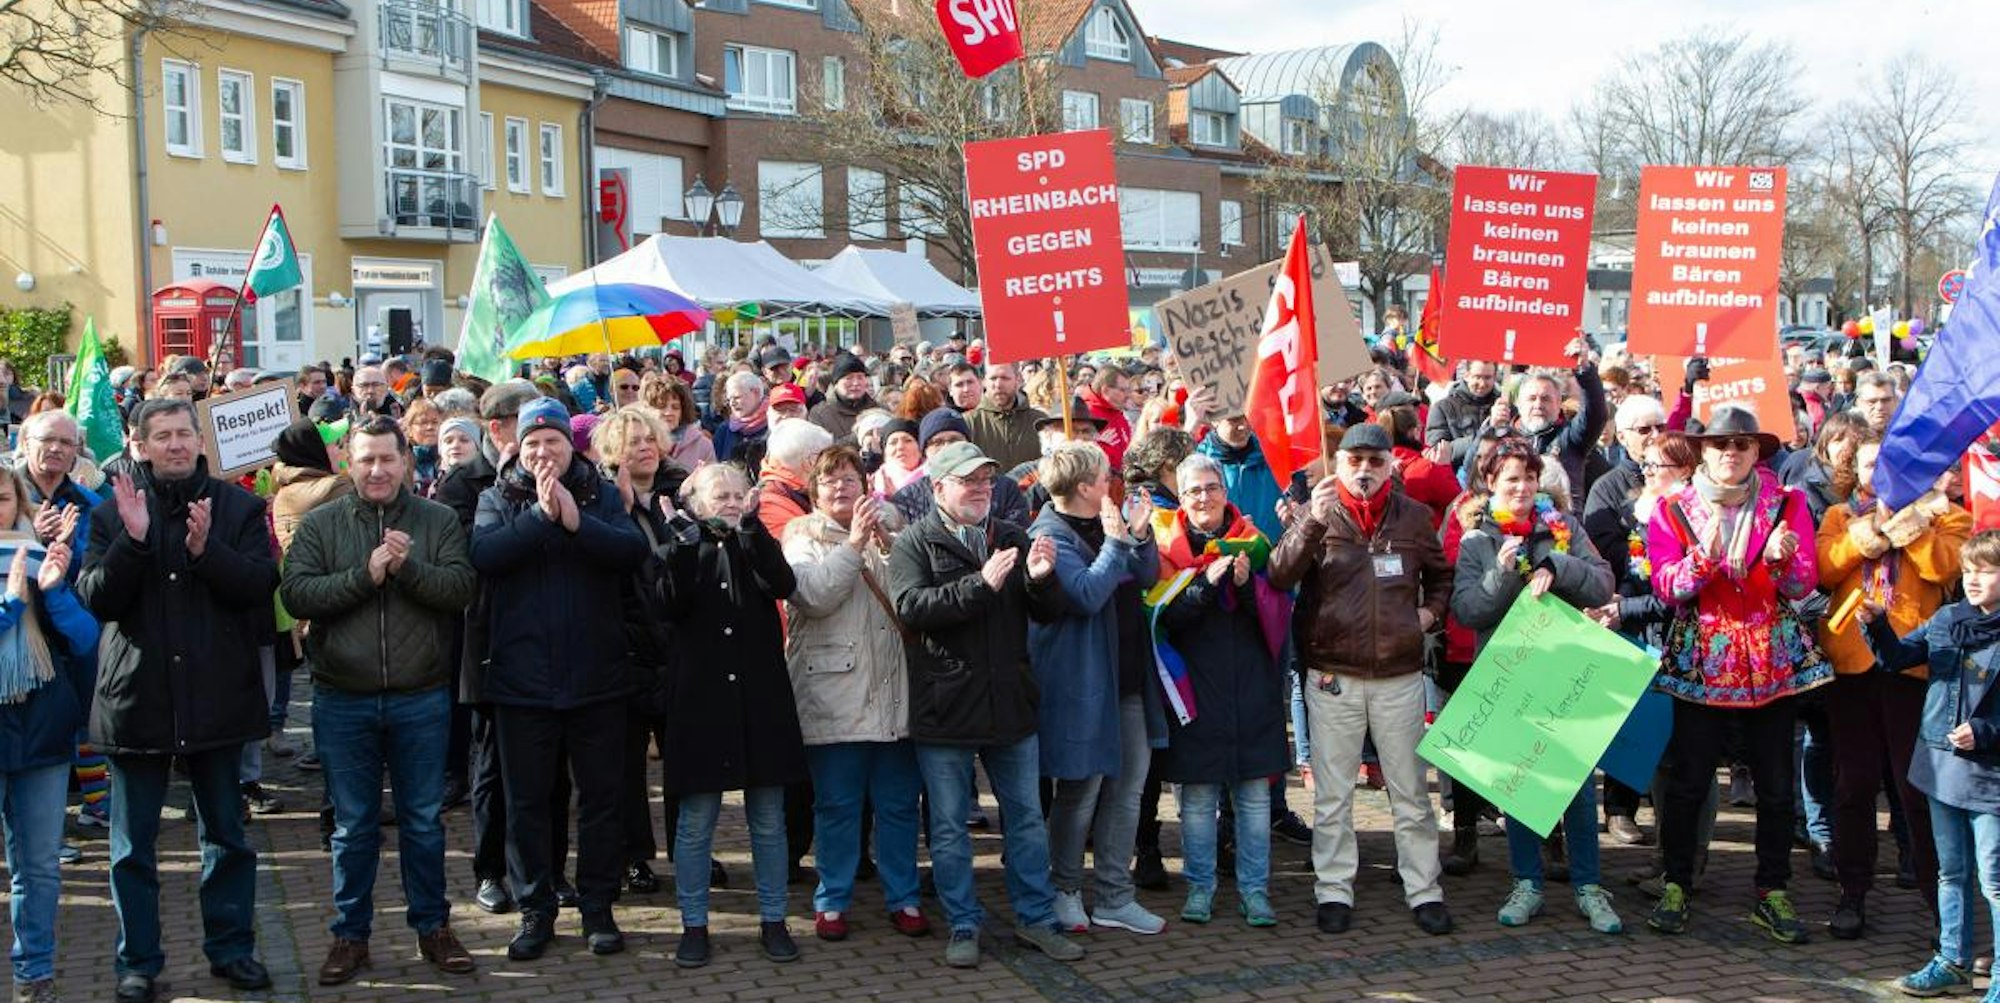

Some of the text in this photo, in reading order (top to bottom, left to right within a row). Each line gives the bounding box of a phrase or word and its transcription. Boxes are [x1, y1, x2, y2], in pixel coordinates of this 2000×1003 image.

[1018, 149, 1066, 172] SPD
[1507, 174, 1547, 193] Wir
[1694, 171, 1734, 188] Wir
[973, 184, 1117, 219] RHEINBACH
[1464, 195, 1585, 220] lassen uns
[1650, 194, 1775, 213] lassen uns
[1484, 221, 1559, 242] keinen
[1671, 217, 1749, 236] keinen
[1008, 228, 1092, 256] GEGEN
[1660, 241, 1756, 260] braunen
[1472, 244, 1565, 268] braunen
[1006, 267, 1102, 297] RECHTS
[1482, 269, 1549, 290] Bären
[1672, 264, 1741, 283] Bären
[1457, 294, 1569, 317] aufbinden
[1646, 288, 1762, 308] aufbinden
[1166, 286, 1244, 336] Nazis
[1053, 310, 1066, 342] !
[1176, 306, 1266, 359] Geschic
[1695, 322, 1708, 354] !
[1503, 329, 1516, 361] !
[1190, 341, 1246, 385] nicht
[1699, 376, 1767, 404] ECHTS
[216, 398, 286, 432] Respekt!
